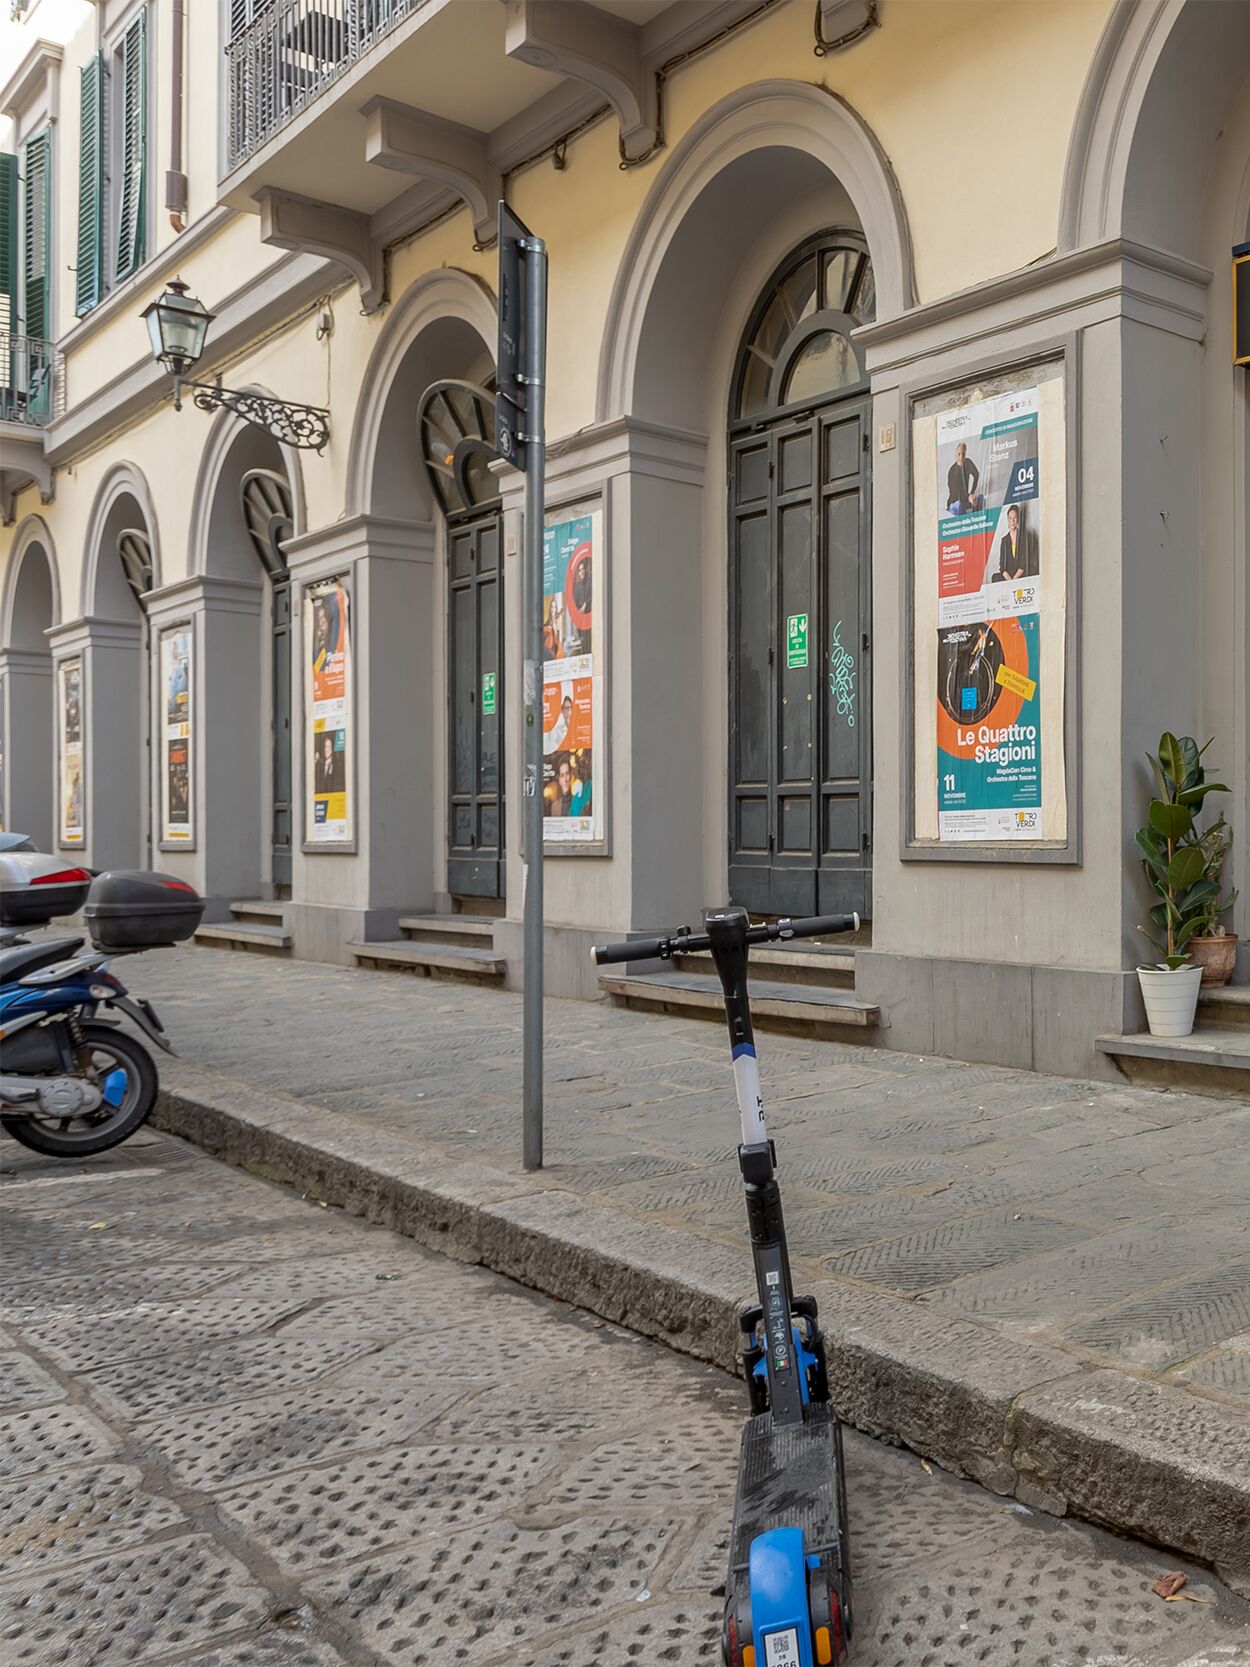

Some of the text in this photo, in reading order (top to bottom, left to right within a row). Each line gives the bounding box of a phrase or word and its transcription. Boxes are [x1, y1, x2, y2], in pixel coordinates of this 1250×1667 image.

[993, 439, 1018, 452] Markus
[1018, 465, 1035, 483] 04
[1013, 595, 1034, 605] VERDI
[957, 724, 1036, 746] Le Quattro
[975, 740, 1036, 766] Stagioni
[944, 774, 955, 791] 11
[1016, 820, 1036, 828] VERDI
